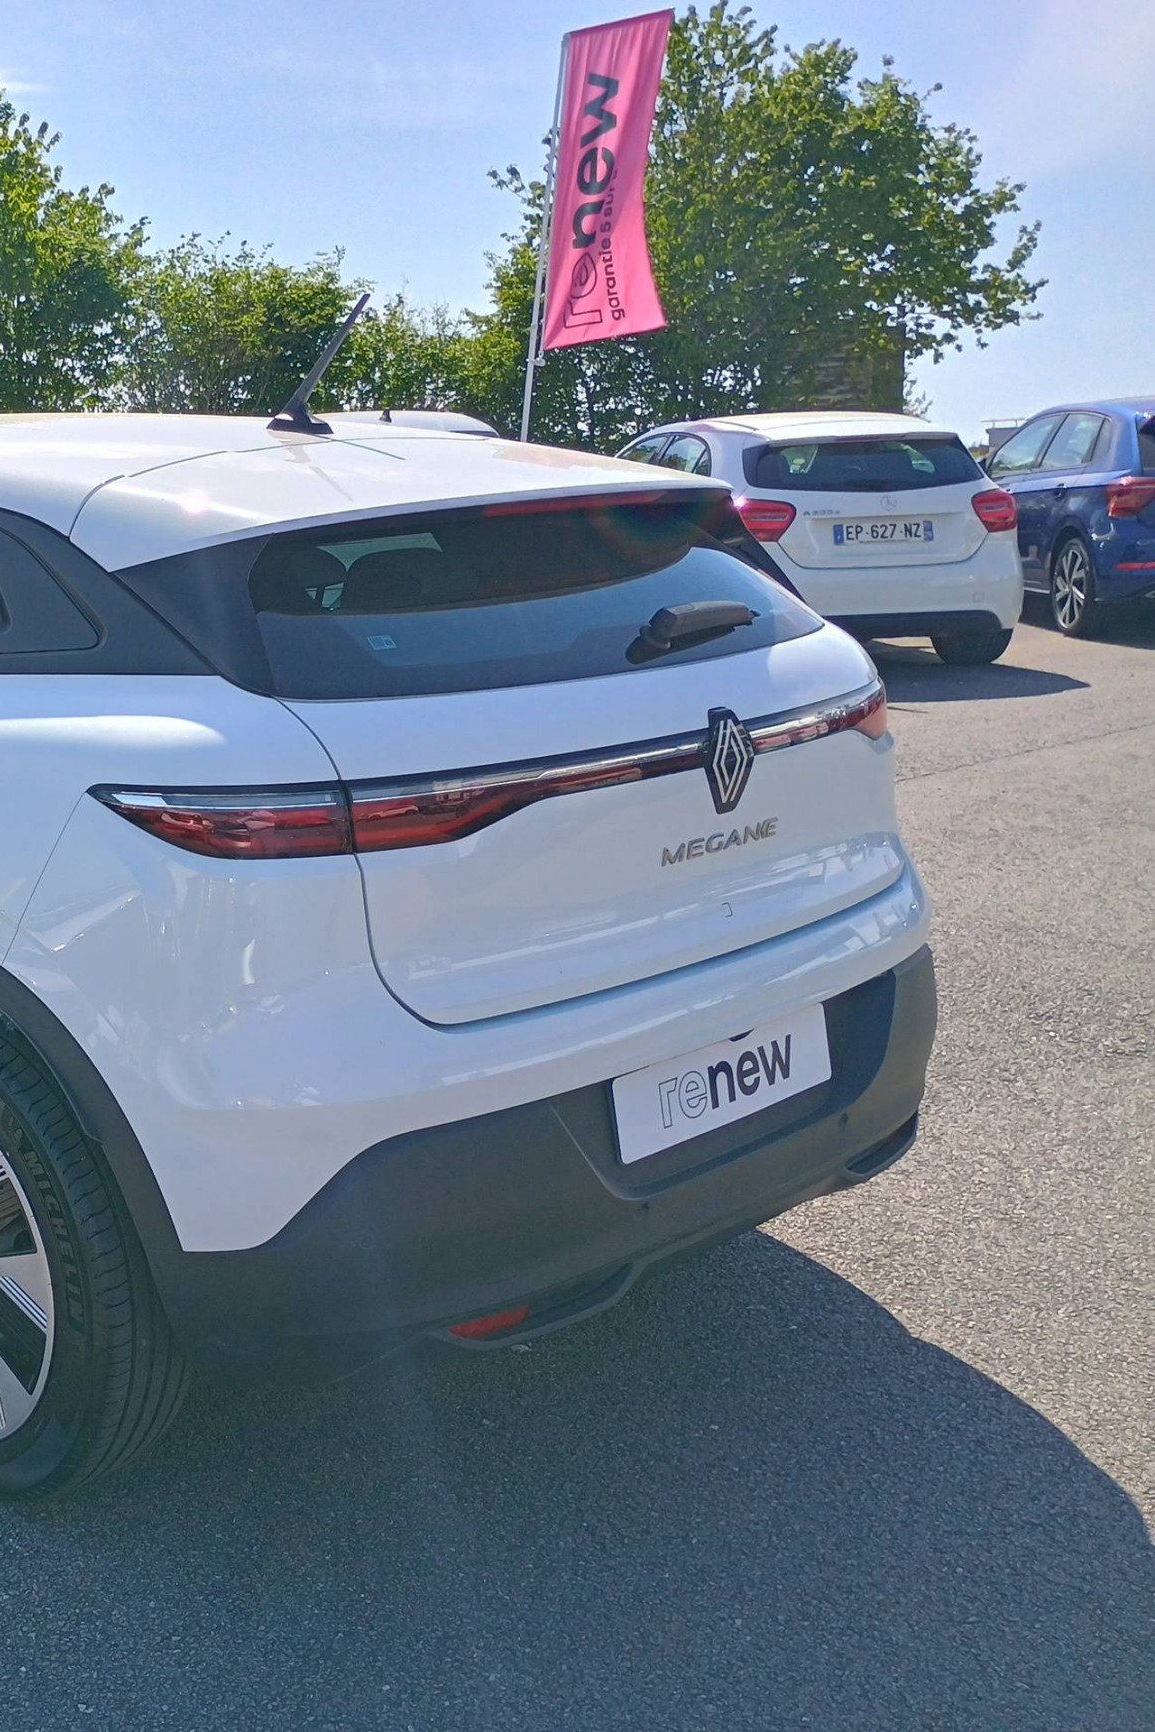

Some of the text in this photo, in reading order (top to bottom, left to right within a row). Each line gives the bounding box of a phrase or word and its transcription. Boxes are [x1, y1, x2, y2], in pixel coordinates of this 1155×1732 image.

[564, 72, 619, 328] renew
[600, 221, 612, 232] 5
[599, 237, 625, 321] garantie
[846, 523, 921, 540] EP-627-NZ
[661, 817, 778, 867] MEGANE
[658, 1034, 792, 1129] renew
[24, 1151, 85, 1327] MICHELIN
